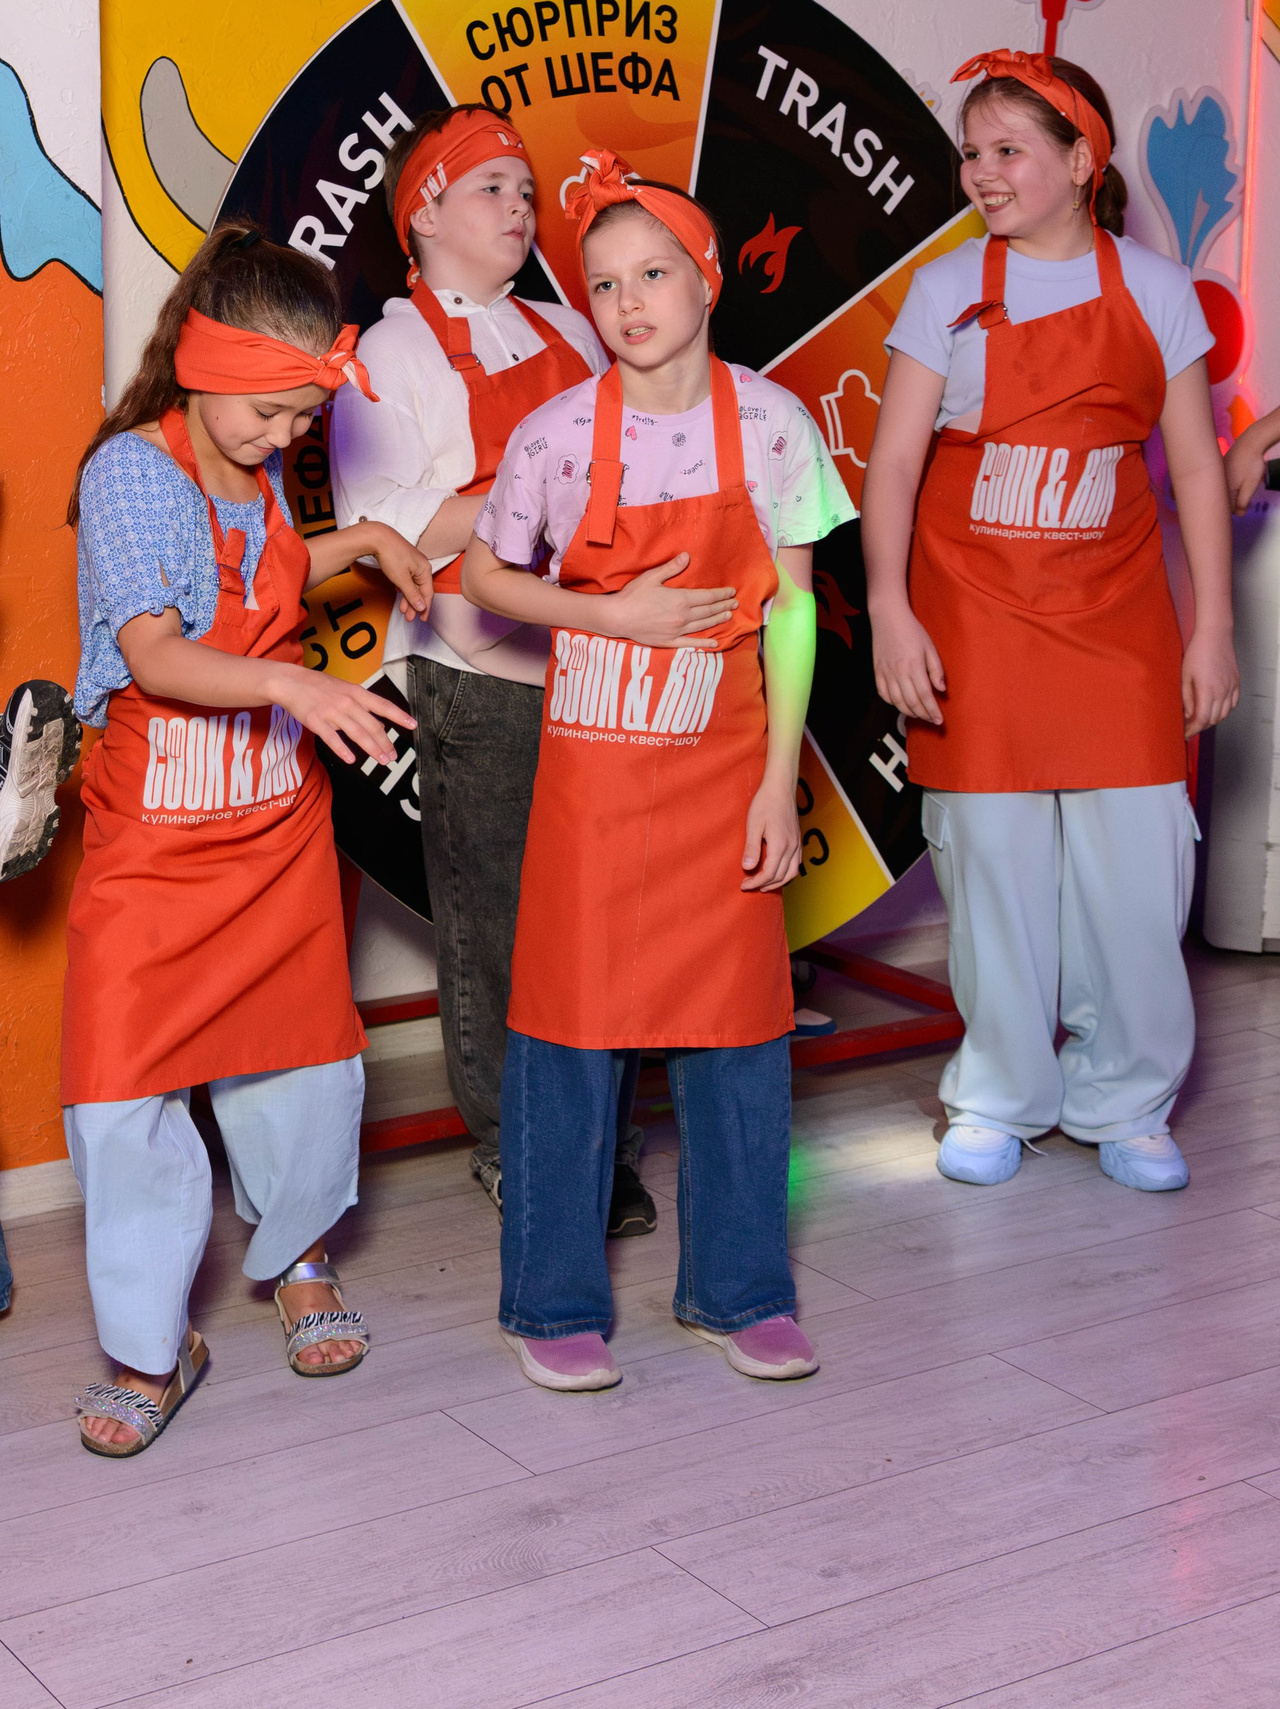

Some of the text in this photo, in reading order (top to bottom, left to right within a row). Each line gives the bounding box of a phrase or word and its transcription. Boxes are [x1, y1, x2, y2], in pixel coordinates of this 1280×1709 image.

[465, 0, 679, 61] СЮРПРИЗ
[480, 51, 681, 114] ОТ ШЕФА
[755, 44, 916, 216] TRASH
[287, 91, 416, 271] RASH
[970, 441, 1125, 529] COOK & RUN
[969, 523, 1105, 541] кулинарное квест-шоу
[549, 629, 725, 735] COOK & RUN
[142, 714, 229, 811] COOK
[228, 711, 255, 808] &
[546, 724, 702, 748] кулинарное квест-шоу
[141, 809, 233, 826] кулинарное
